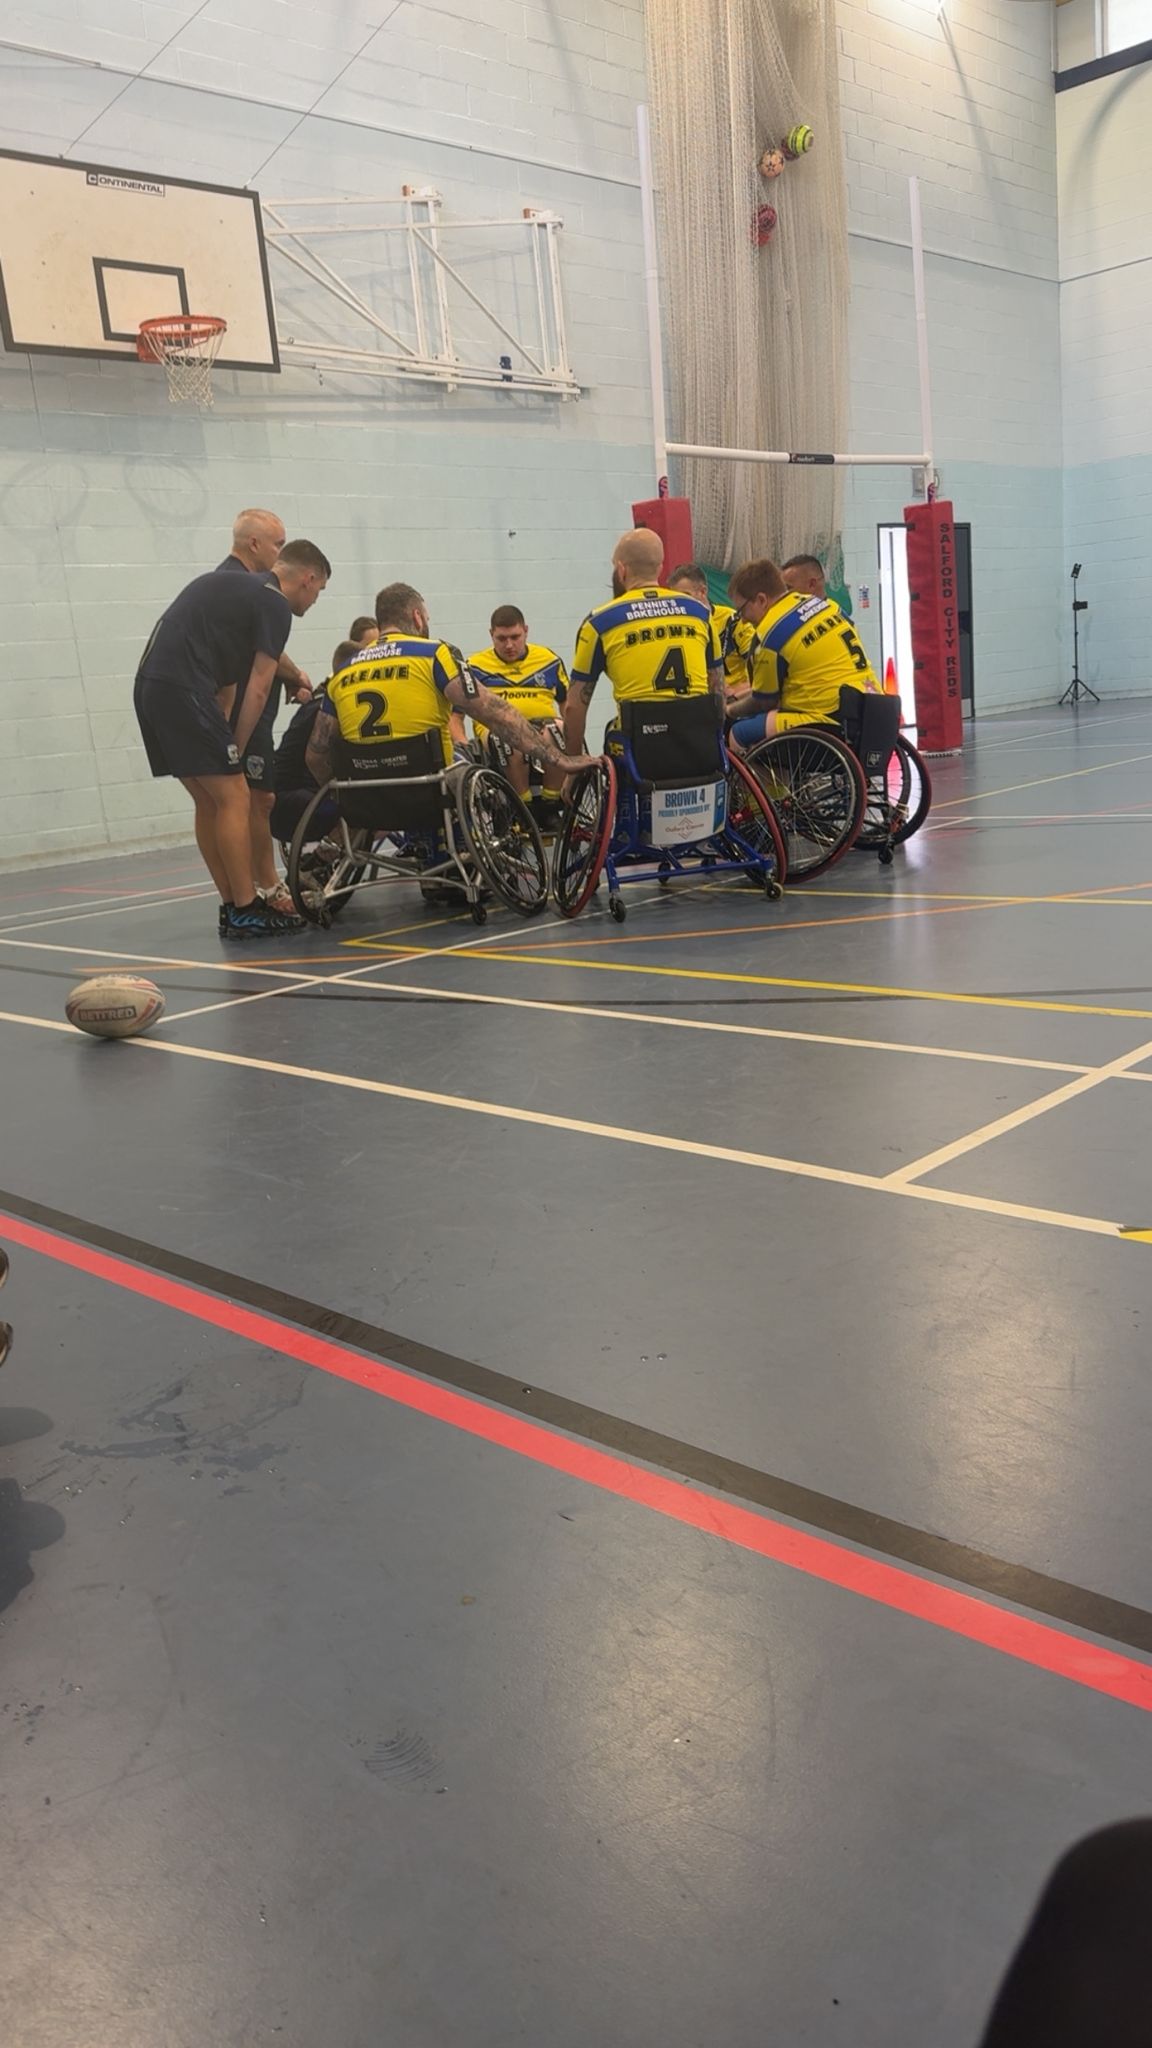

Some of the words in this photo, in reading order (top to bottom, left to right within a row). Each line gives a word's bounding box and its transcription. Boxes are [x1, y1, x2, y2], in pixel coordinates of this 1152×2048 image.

[87, 173, 163, 193] CONTINENTAL
[941, 523, 953, 598] SALFORD
[625, 606, 688, 620] BAKEHOUSE
[630, 599, 678, 611] PENNIE'S
[944, 607, 955, 648] CITY
[652, 646, 691, 695] 4
[841, 629, 868, 671] 5
[946, 656, 958, 698] REDS
[356, 689, 391, 739] 2
[664, 789, 698, 808] BROWN
[699, 788, 706, 803] 4
[80, 1008, 135, 1021] BETFRED
